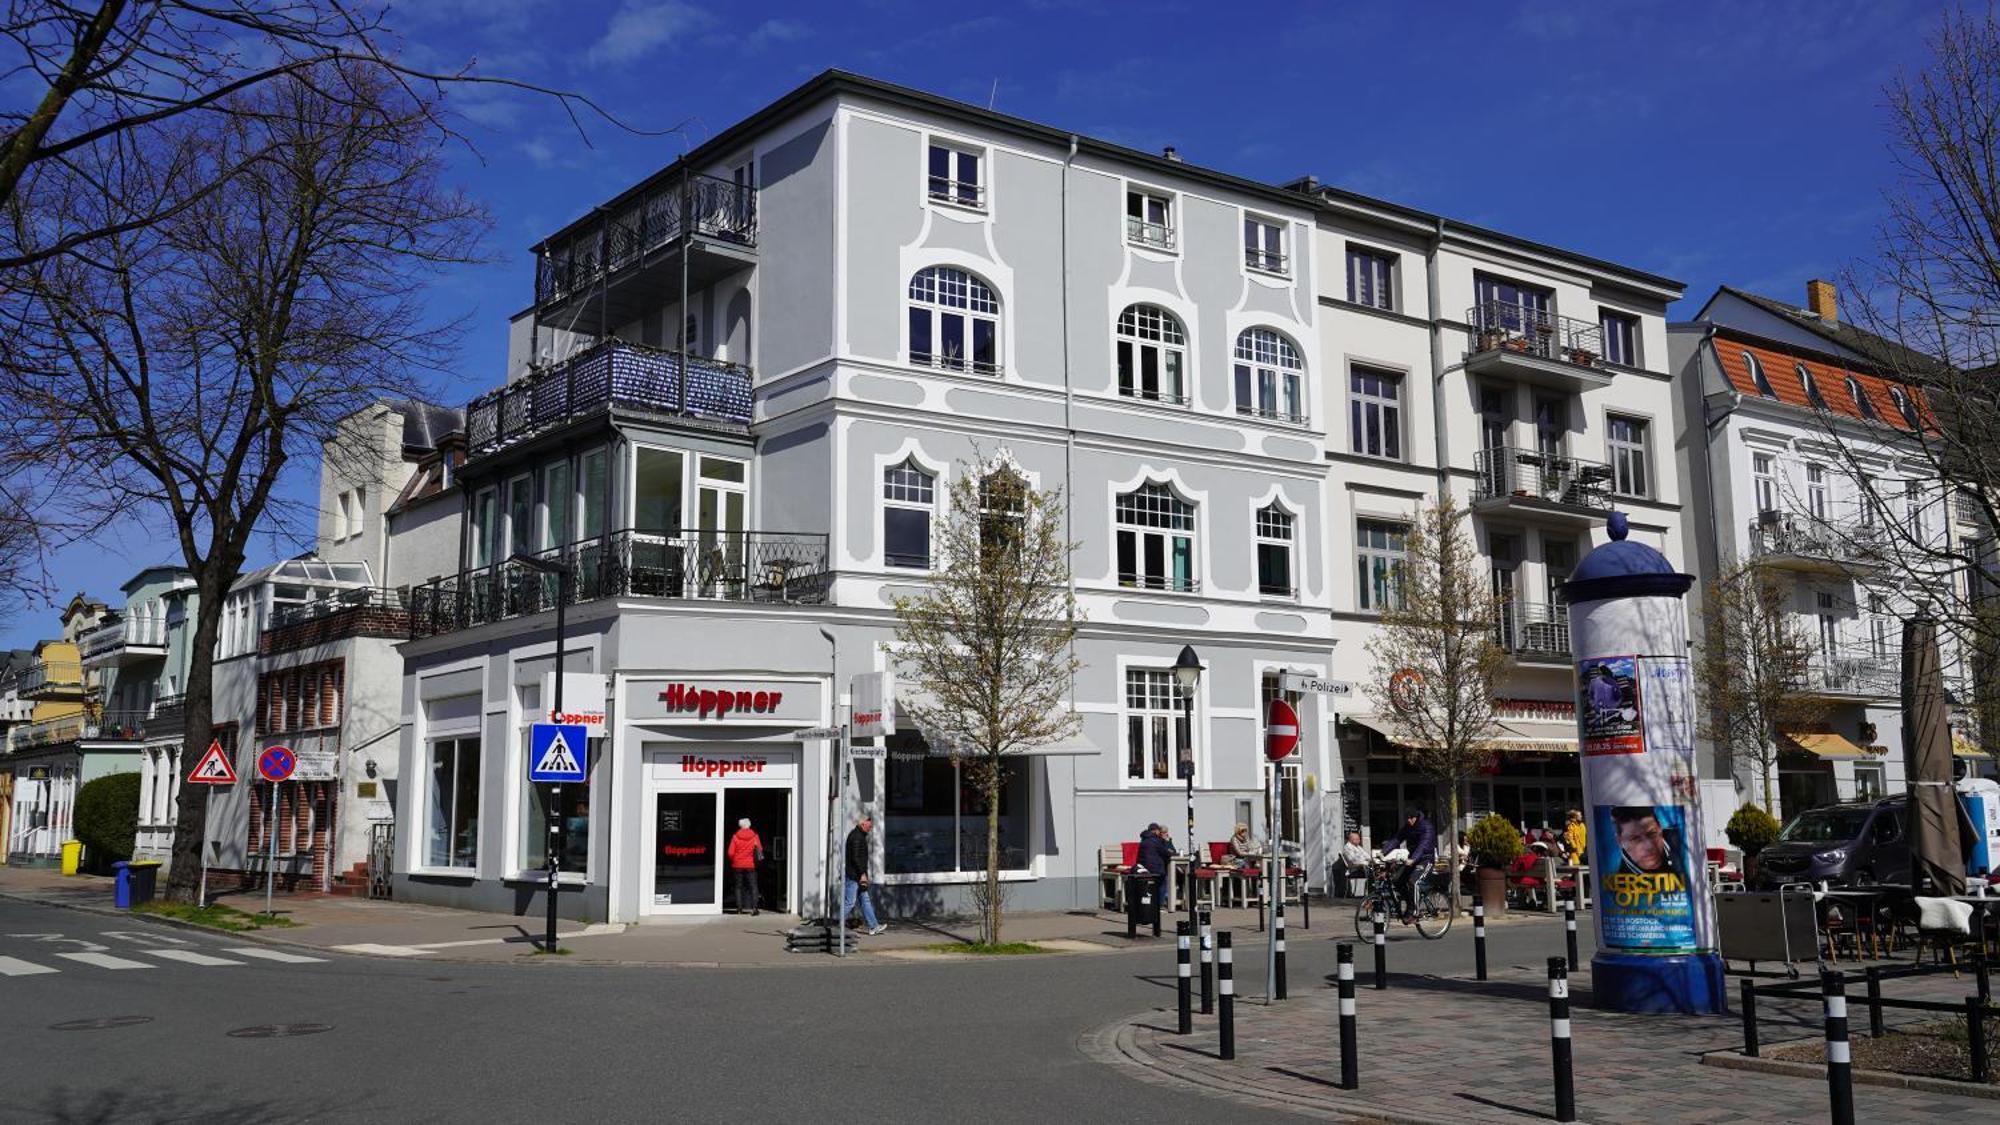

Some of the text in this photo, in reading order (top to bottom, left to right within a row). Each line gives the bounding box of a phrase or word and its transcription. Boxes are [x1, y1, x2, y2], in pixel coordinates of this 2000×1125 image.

[1311, 680, 1344, 693] Polizei
[850, 747, 885, 757] Kirchenplatz
[1602, 872, 1686, 893] KERSTIN
[1615, 890, 1656, 907] OTT
[1661, 893, 1687, 902] LIVE
